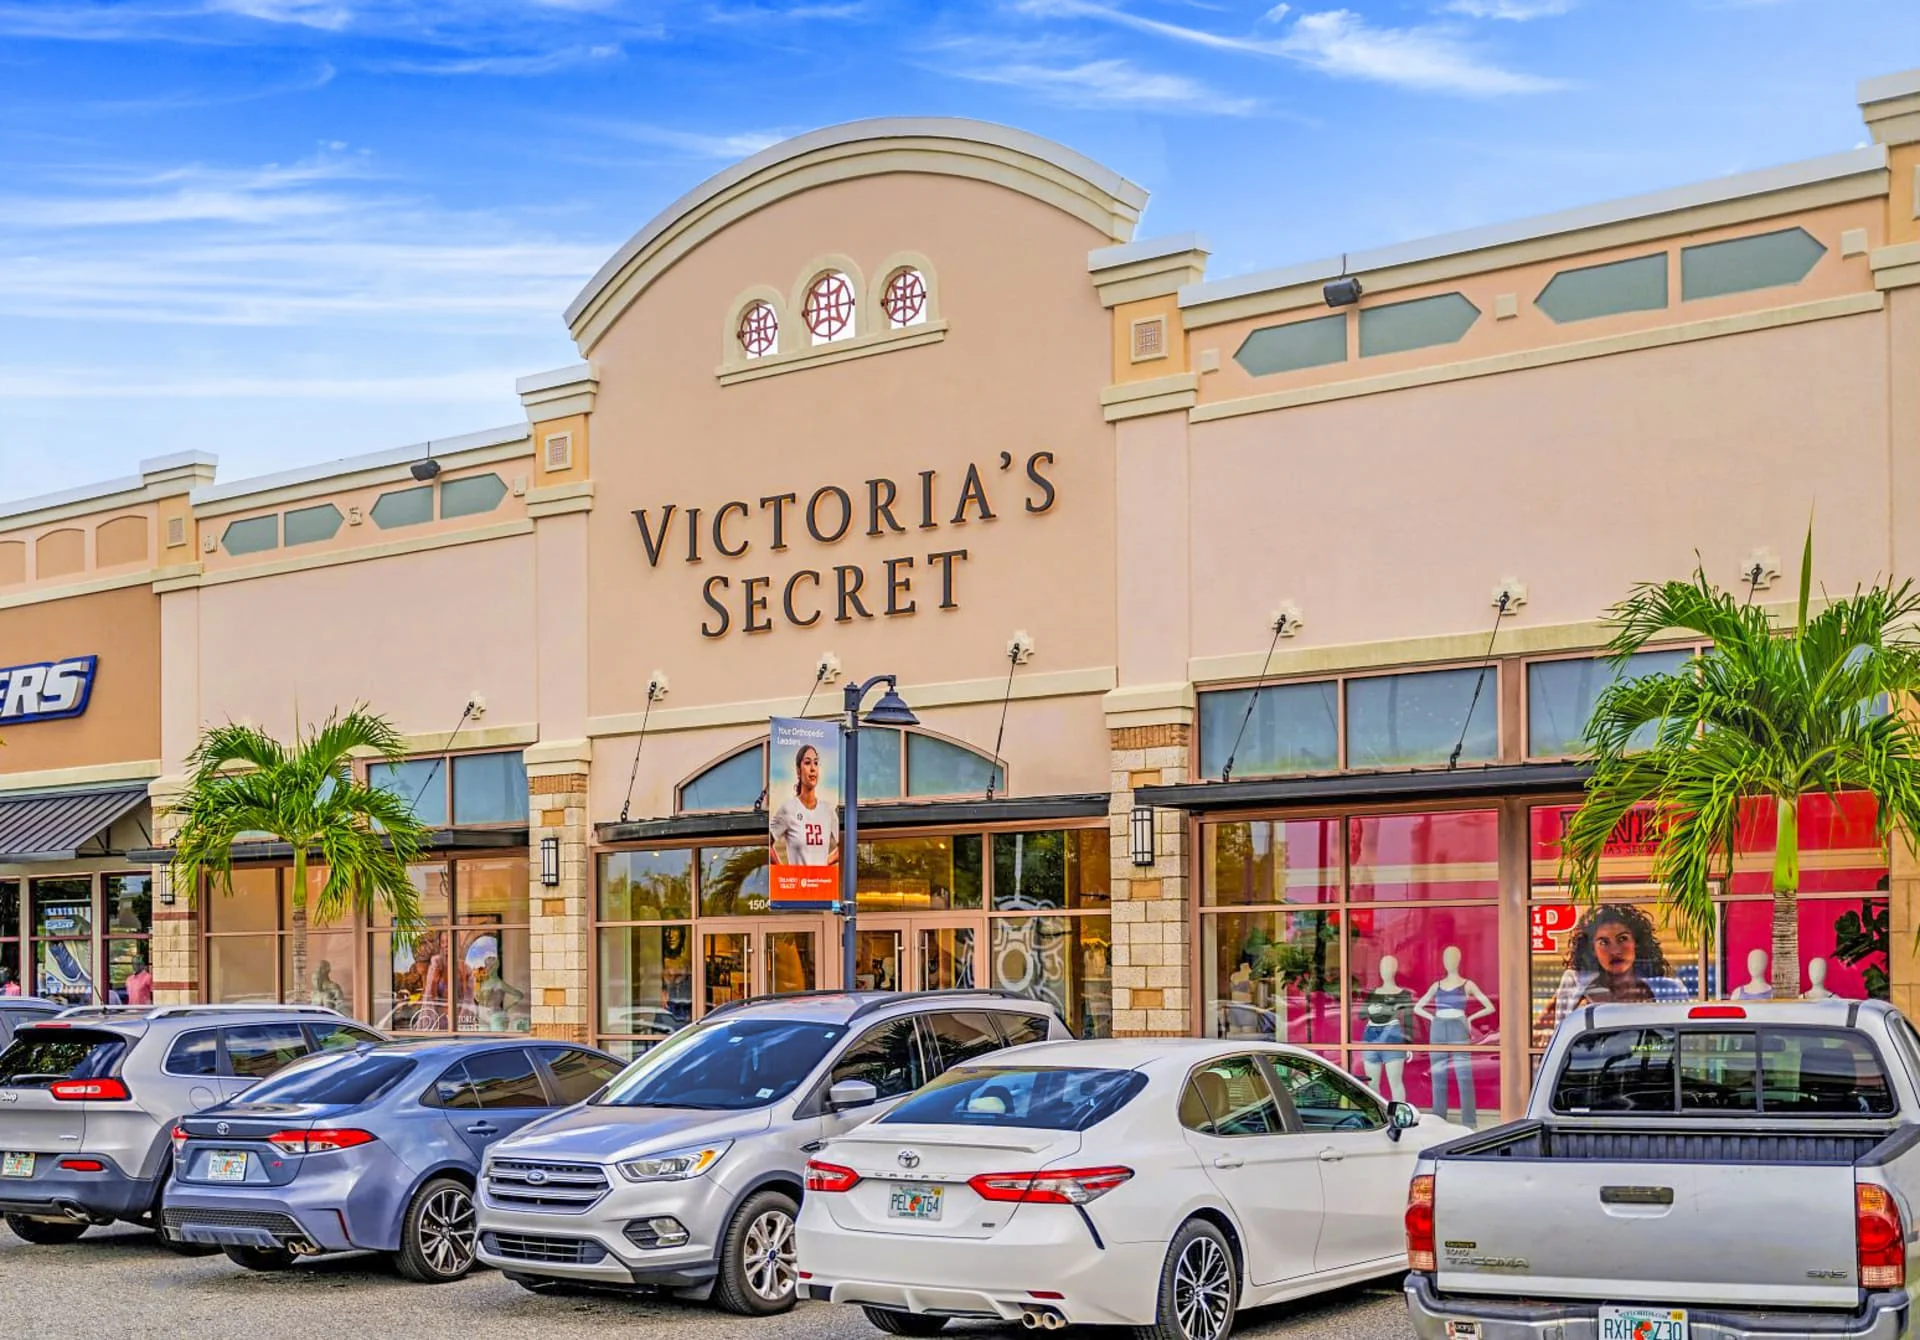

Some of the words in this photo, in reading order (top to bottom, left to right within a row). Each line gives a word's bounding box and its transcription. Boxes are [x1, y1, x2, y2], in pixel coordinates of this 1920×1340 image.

[631, 451, 1056, 567] VICTORIA'S
[702, 549, 968, 638] SECRET
[805, 823, 823, 846] 22
[1604, 1318, 1633, 1340] RXH
